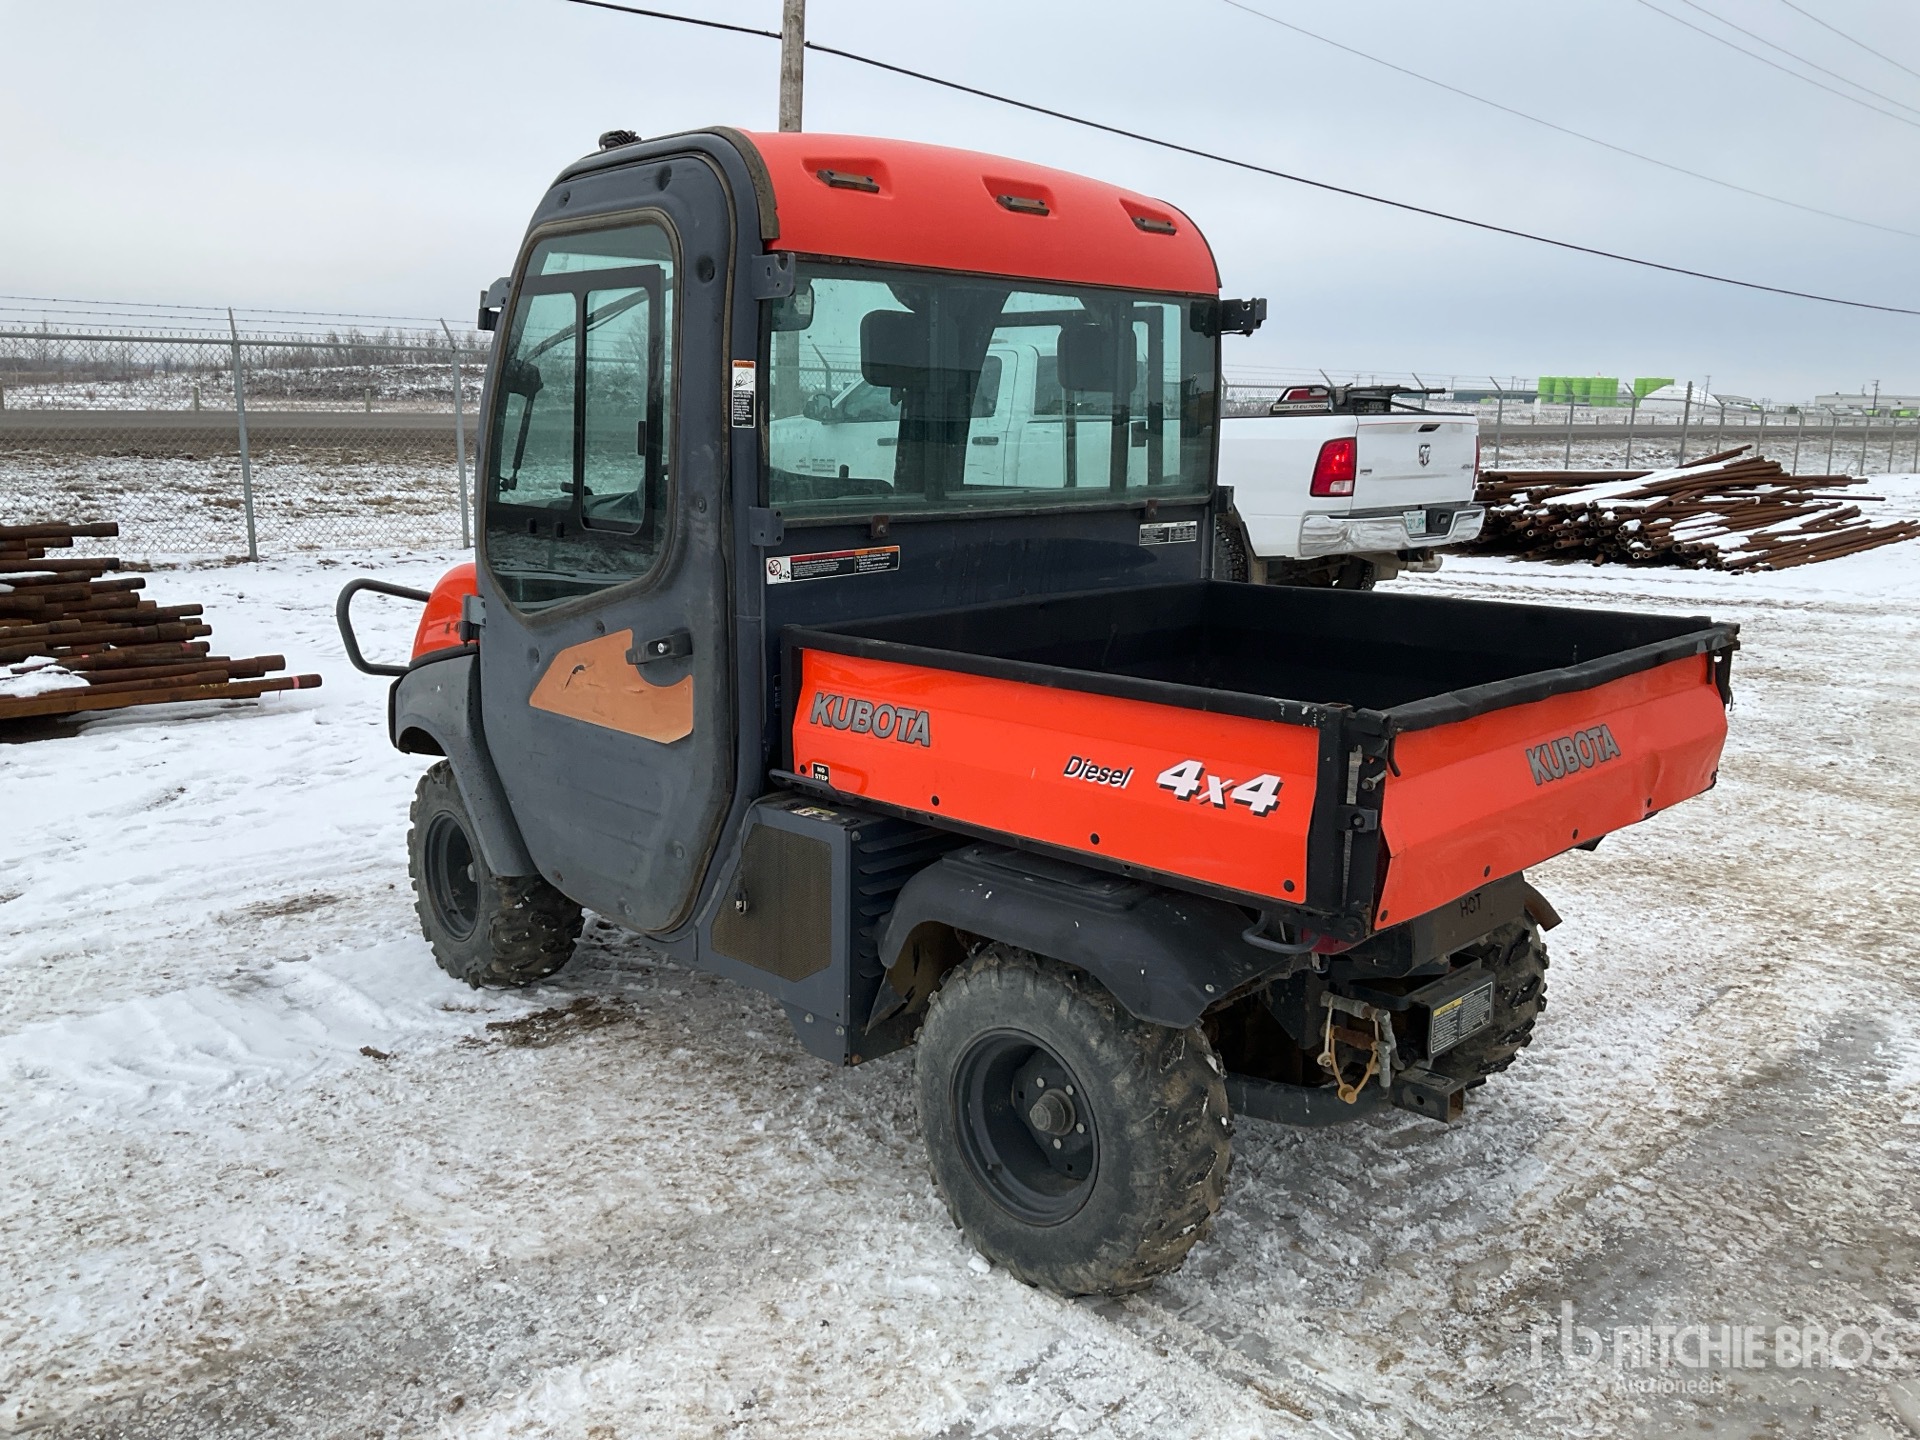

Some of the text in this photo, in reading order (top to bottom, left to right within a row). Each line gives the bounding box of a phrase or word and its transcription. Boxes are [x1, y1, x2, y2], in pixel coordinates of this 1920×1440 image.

[810, 692, 931, 747] KUBOTA
[814, 773, 828, 781] STEP
[1526, 723, 1621, 785] KUBOTA
[1063, 755, 1283, 817] Diesel 4x4
[1460, 892, 1482, 917] HOT
